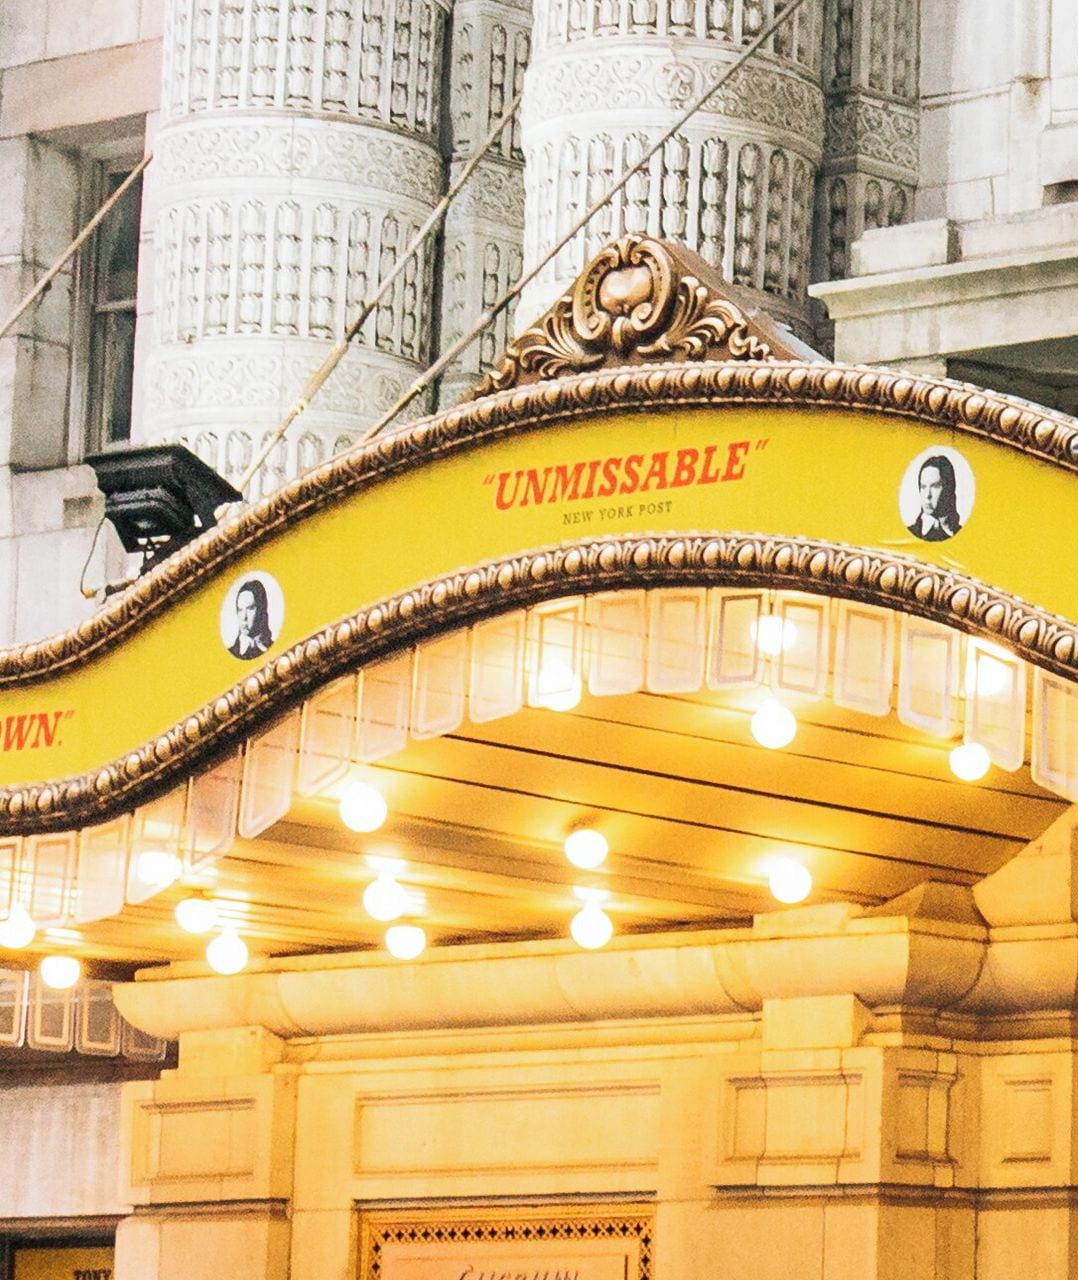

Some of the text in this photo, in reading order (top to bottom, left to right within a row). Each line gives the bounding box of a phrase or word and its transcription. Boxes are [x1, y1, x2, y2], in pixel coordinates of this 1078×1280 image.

[482, 439, 770, 511] "UNMISSABLE"
[562, 501, 673, 526] NEW YORK POST
